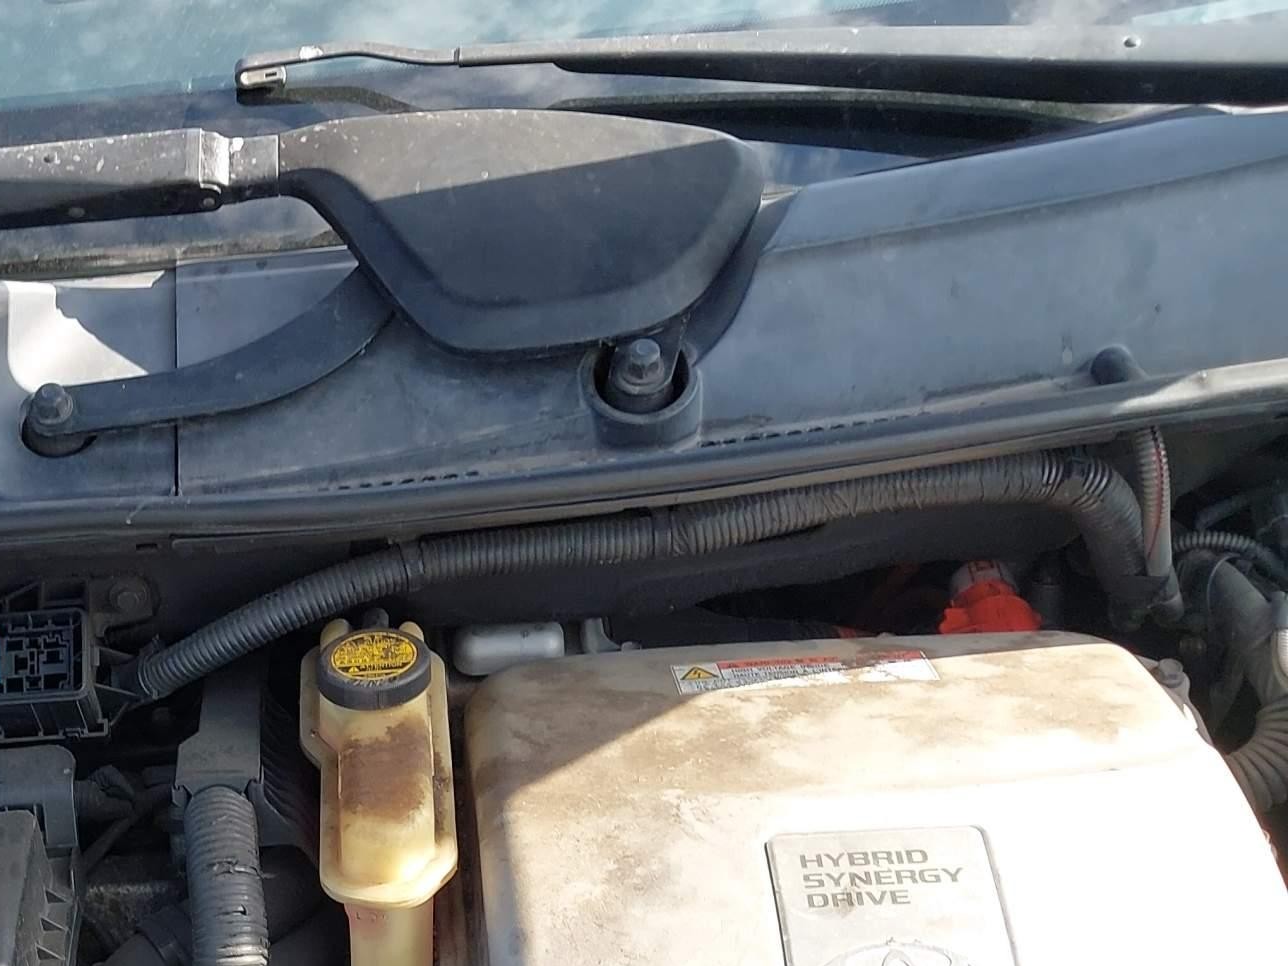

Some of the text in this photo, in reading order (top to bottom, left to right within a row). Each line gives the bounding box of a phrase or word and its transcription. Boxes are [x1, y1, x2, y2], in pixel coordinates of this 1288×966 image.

[799, 849, 928, 869] HYBRID
[802, 867, 963, 889] SYNERGY
[807, 889, 911, 908] DRIVE
